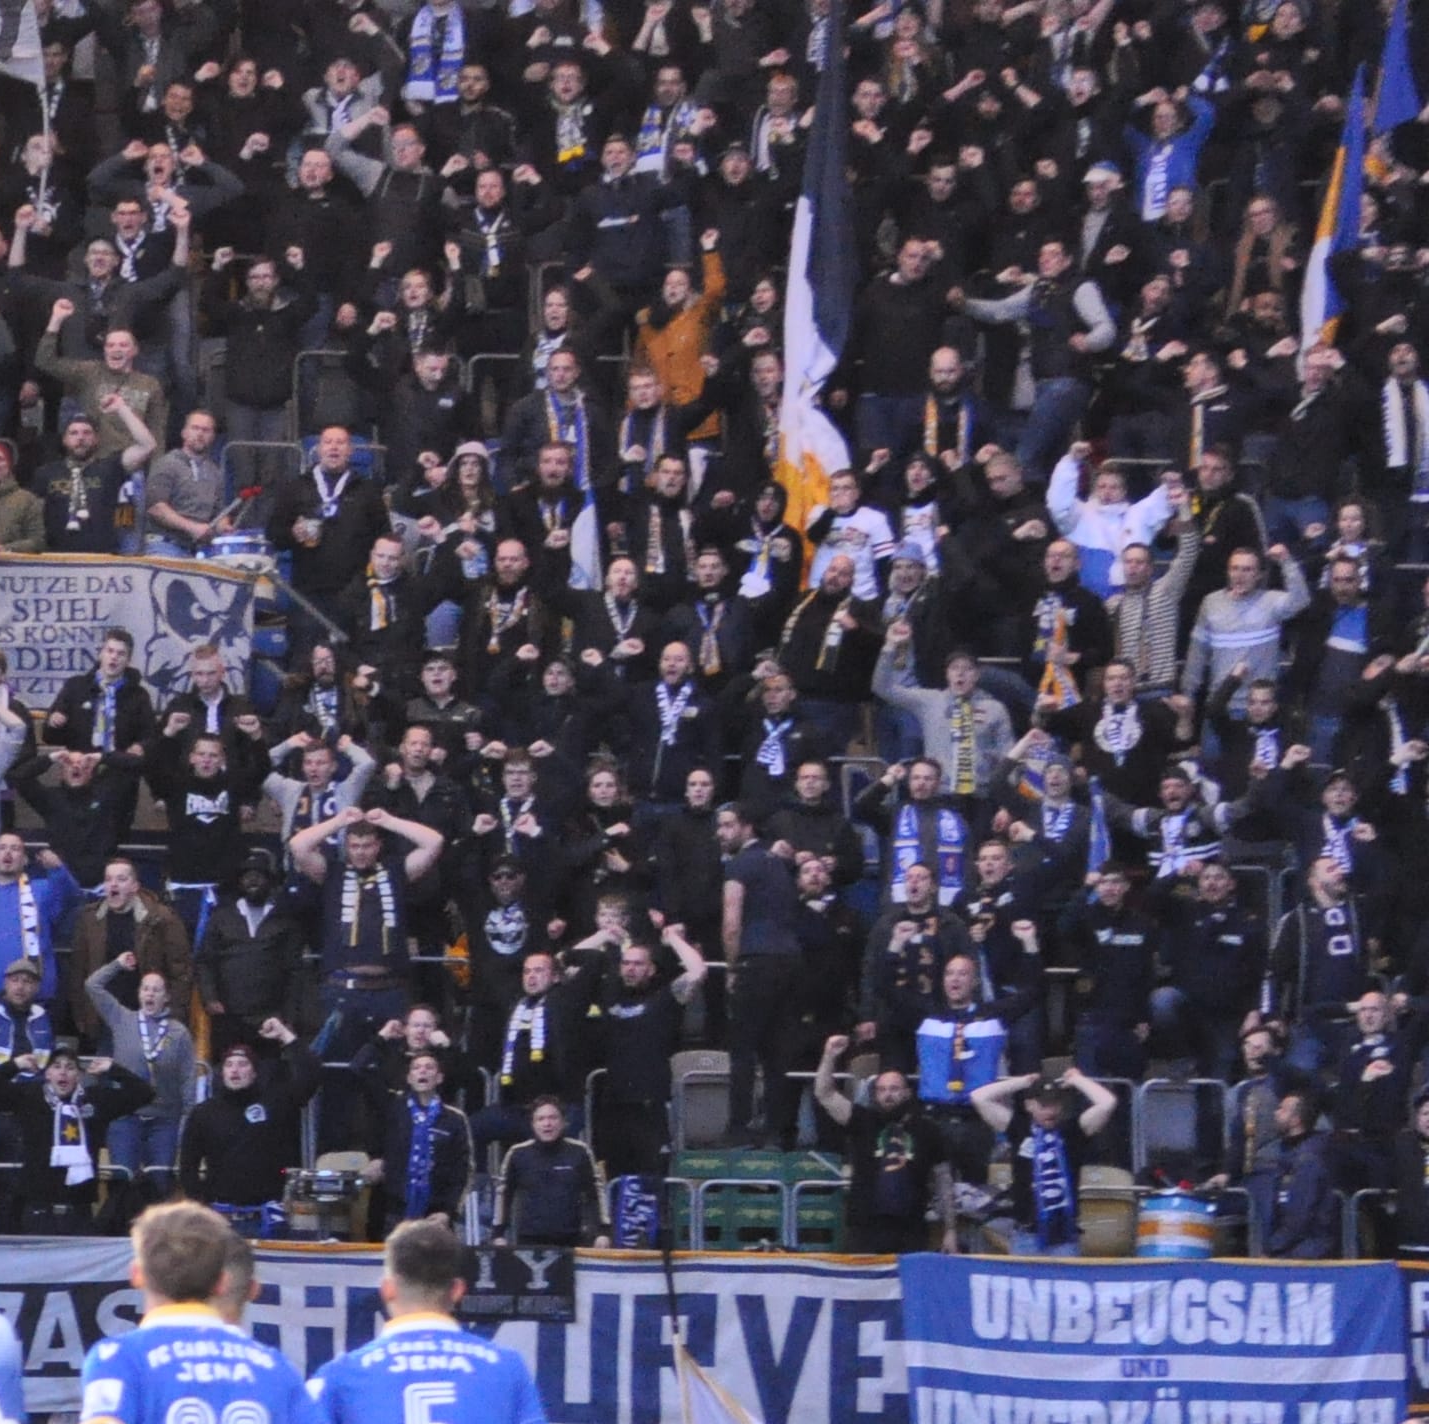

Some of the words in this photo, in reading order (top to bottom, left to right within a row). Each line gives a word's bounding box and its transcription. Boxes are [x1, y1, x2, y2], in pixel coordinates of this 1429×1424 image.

[85, 576, 134, 594] DAS
[11, 598, 110, 623] SPIEL
[970, 1273, 1336, 1346] UNBEUGSAM
[175, 1361, 256, 1384] JENA
[388, 1354, 475, 1374] JENA
[1119, 1357, 1169, 1379] UND
